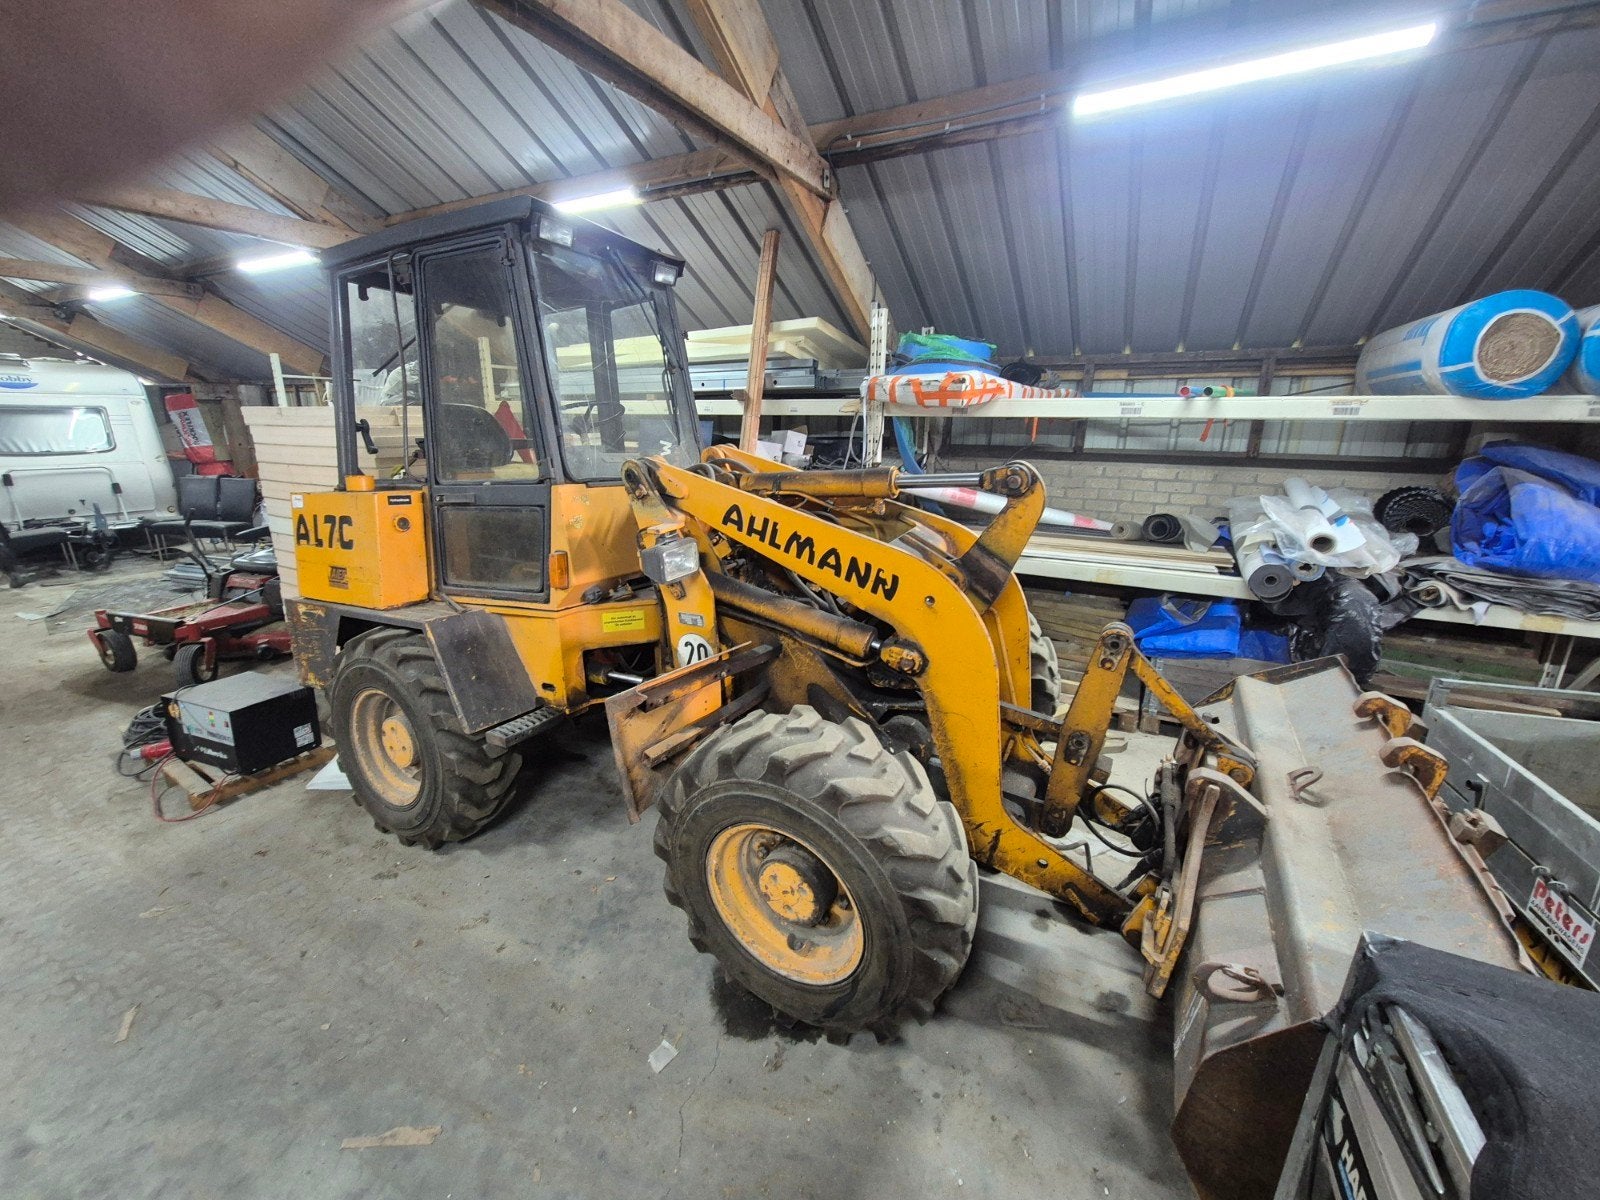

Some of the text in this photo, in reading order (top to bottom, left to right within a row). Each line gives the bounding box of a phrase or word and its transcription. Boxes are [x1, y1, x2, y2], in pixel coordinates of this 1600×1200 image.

[297, 514, 354, 550] AL7C
[721, 503, 899, 602] AHLMANN
[684, 641, 709, 665] 20
[1533, 880, 1590, 945] Peters
